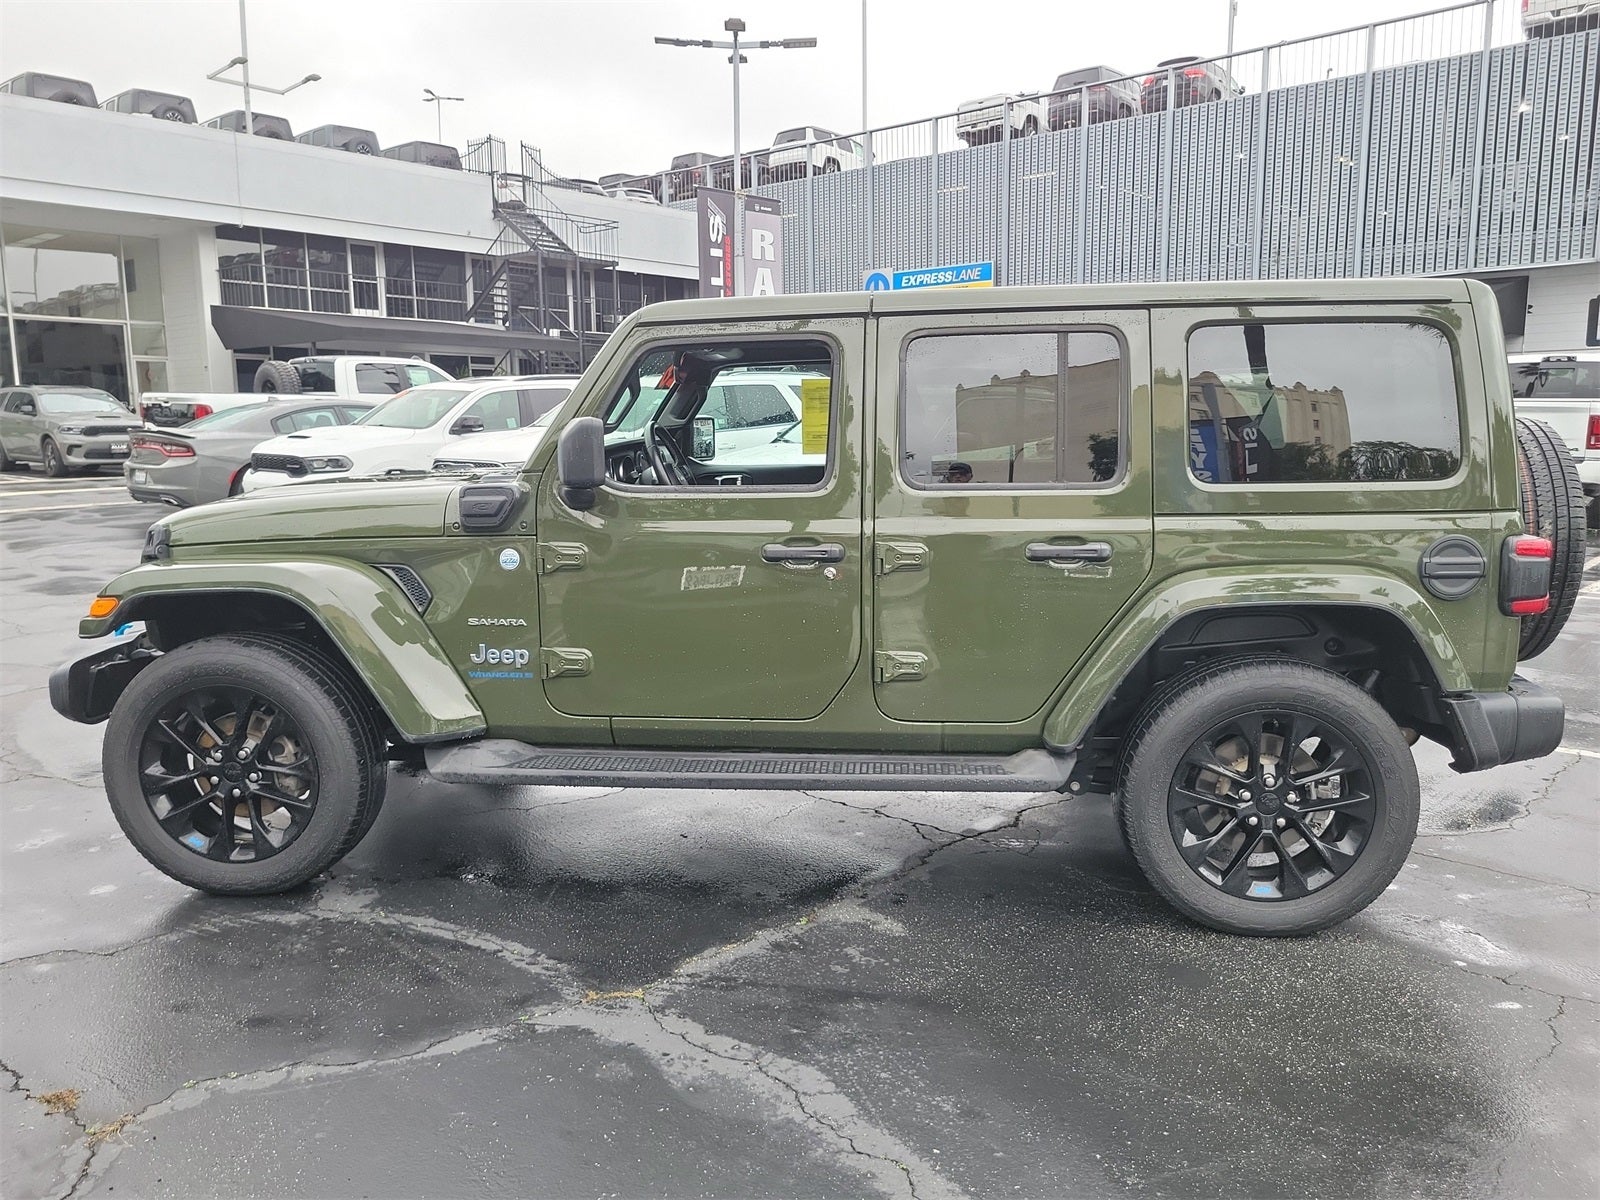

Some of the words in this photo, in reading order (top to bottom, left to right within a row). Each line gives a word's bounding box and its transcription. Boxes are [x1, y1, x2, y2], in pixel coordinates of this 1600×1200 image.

[709, 214, 724, 297] LIS
[752, 229, 776, 296] RA
[467, 617, 527, 627] SAHARA
[470, 643, 529, 669] Jeep
[468, 671, 522, 679] WRANGLER
